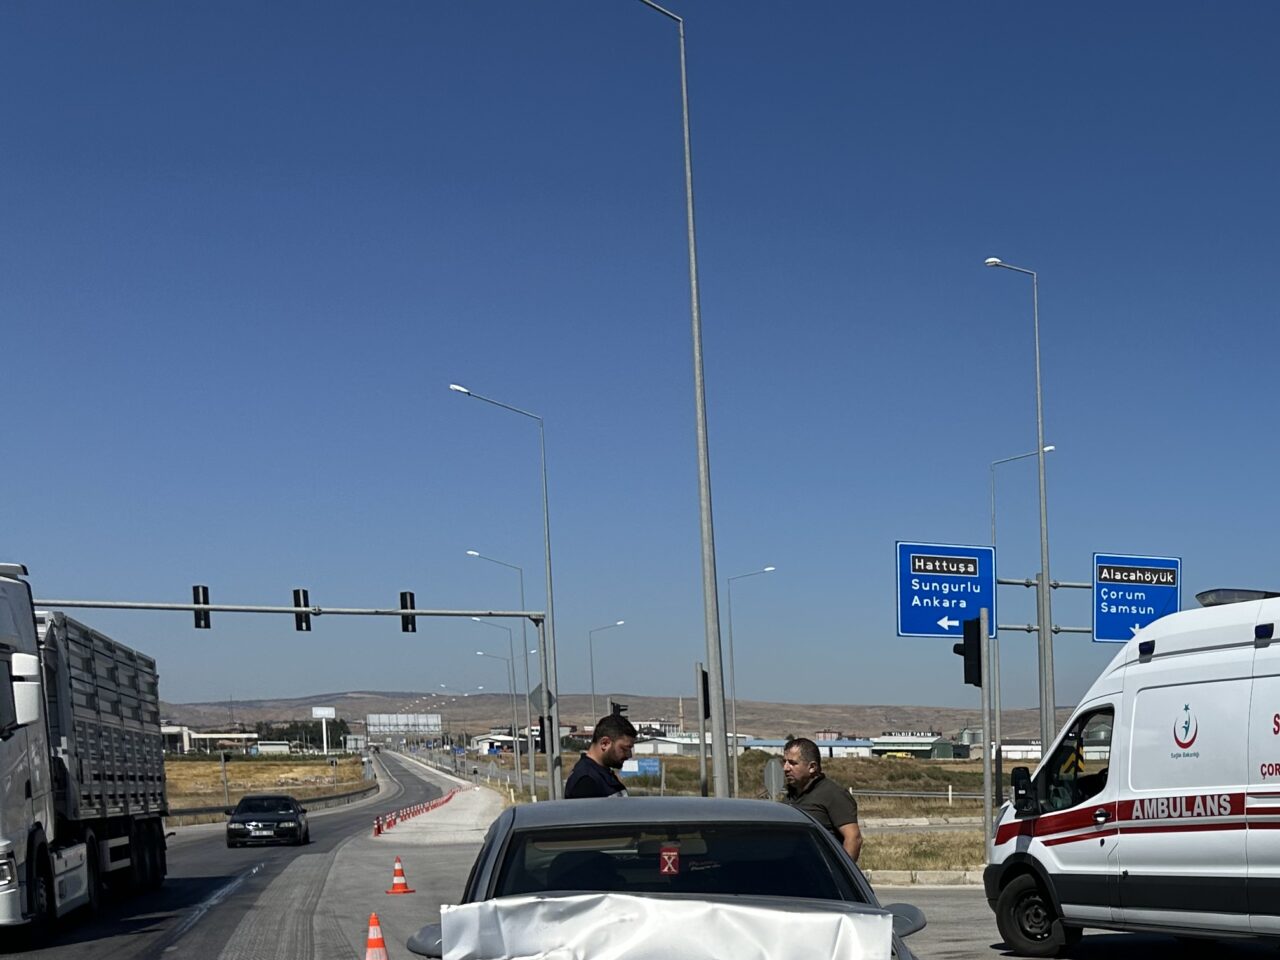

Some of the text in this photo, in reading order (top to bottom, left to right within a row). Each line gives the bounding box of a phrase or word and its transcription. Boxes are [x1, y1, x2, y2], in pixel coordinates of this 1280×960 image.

[914, 558, 976, 574] Hattuşa
[1100, 568, 1174, 584] Alacahöyük
[911, 578, 981, 594] Sungurlu
[911, 595, 967, 608] Ankara
[1100, 587, 1147, 602] Çorum
[1100, 602, 1155, 615] Samsun
[1131, 794, 1232, 820] AMBULANS
